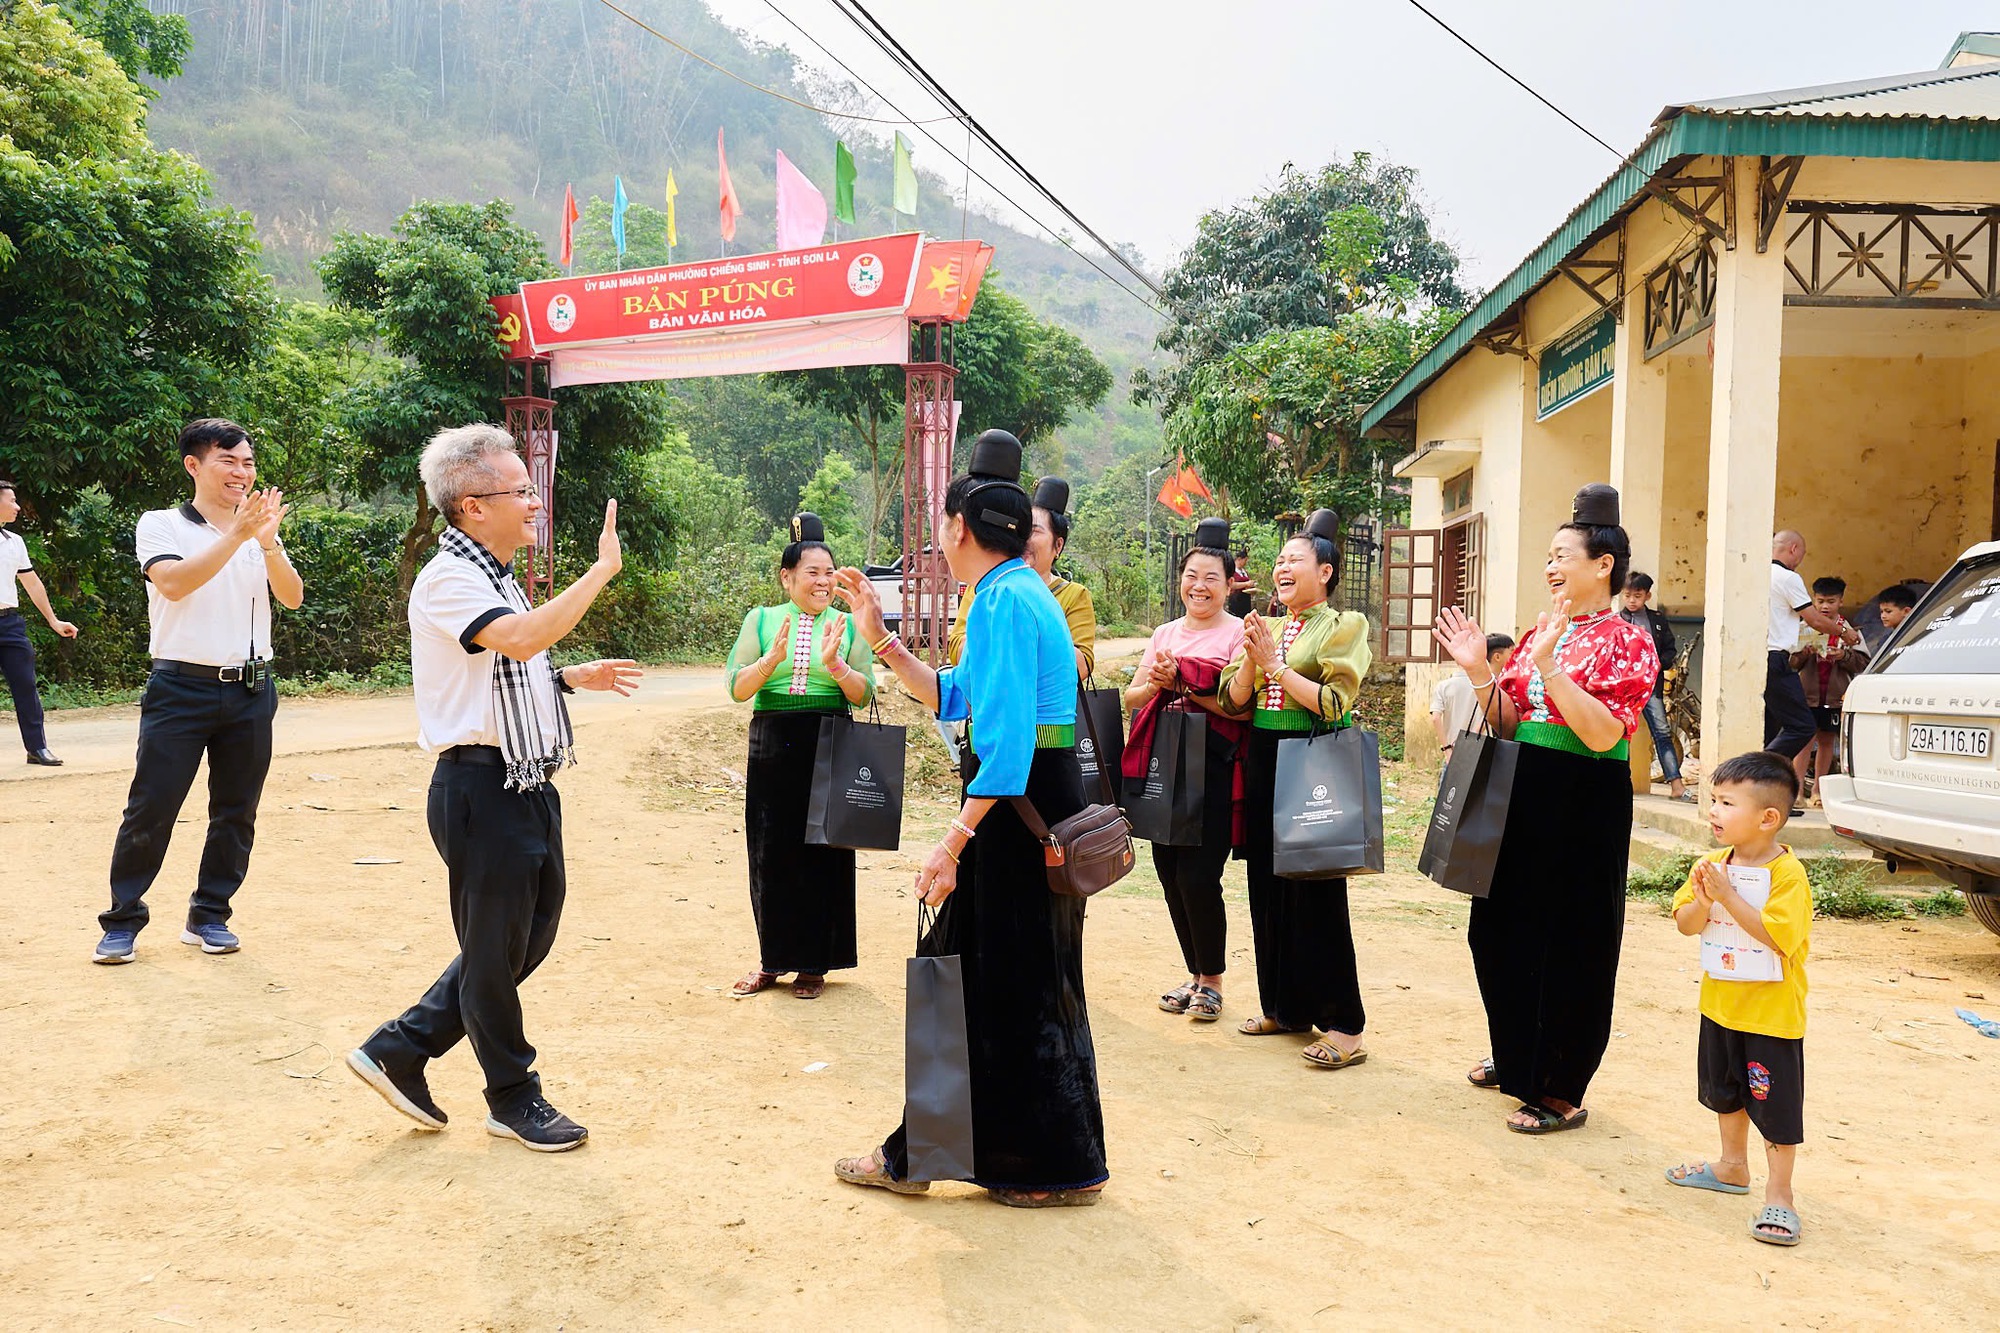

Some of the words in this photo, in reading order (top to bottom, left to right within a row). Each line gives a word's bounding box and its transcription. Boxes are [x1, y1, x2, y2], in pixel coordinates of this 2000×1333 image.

[585, 280, 597, 291] ỦY
[599, 280, 617, 289] BAN
[620, 277, 644, 287] NHÂN
[647, 273, 666, 284] DÂN
[669, 268, 707, 280] PHƯỜNG
[747, 260, 769, 272] SINH
[777, 254, 800, 267] TỈNH
[803, 252, 824, 264] SƠN
[826, 251, 839, 261] LA
[623, 286, 689, 315] BẢN
[699, 277, 796, 307] PÚNG
[649, 313, 683, 329] BẢN
[688, 310, 724, 325] VĂN
[729, 305, 766, 320] HÓA
[1557, 361, 1583, 401] TRƯỜNG
[1584, 344, 1600, 385] BẢN
[1881, 696, 1936, 706] RANGE
